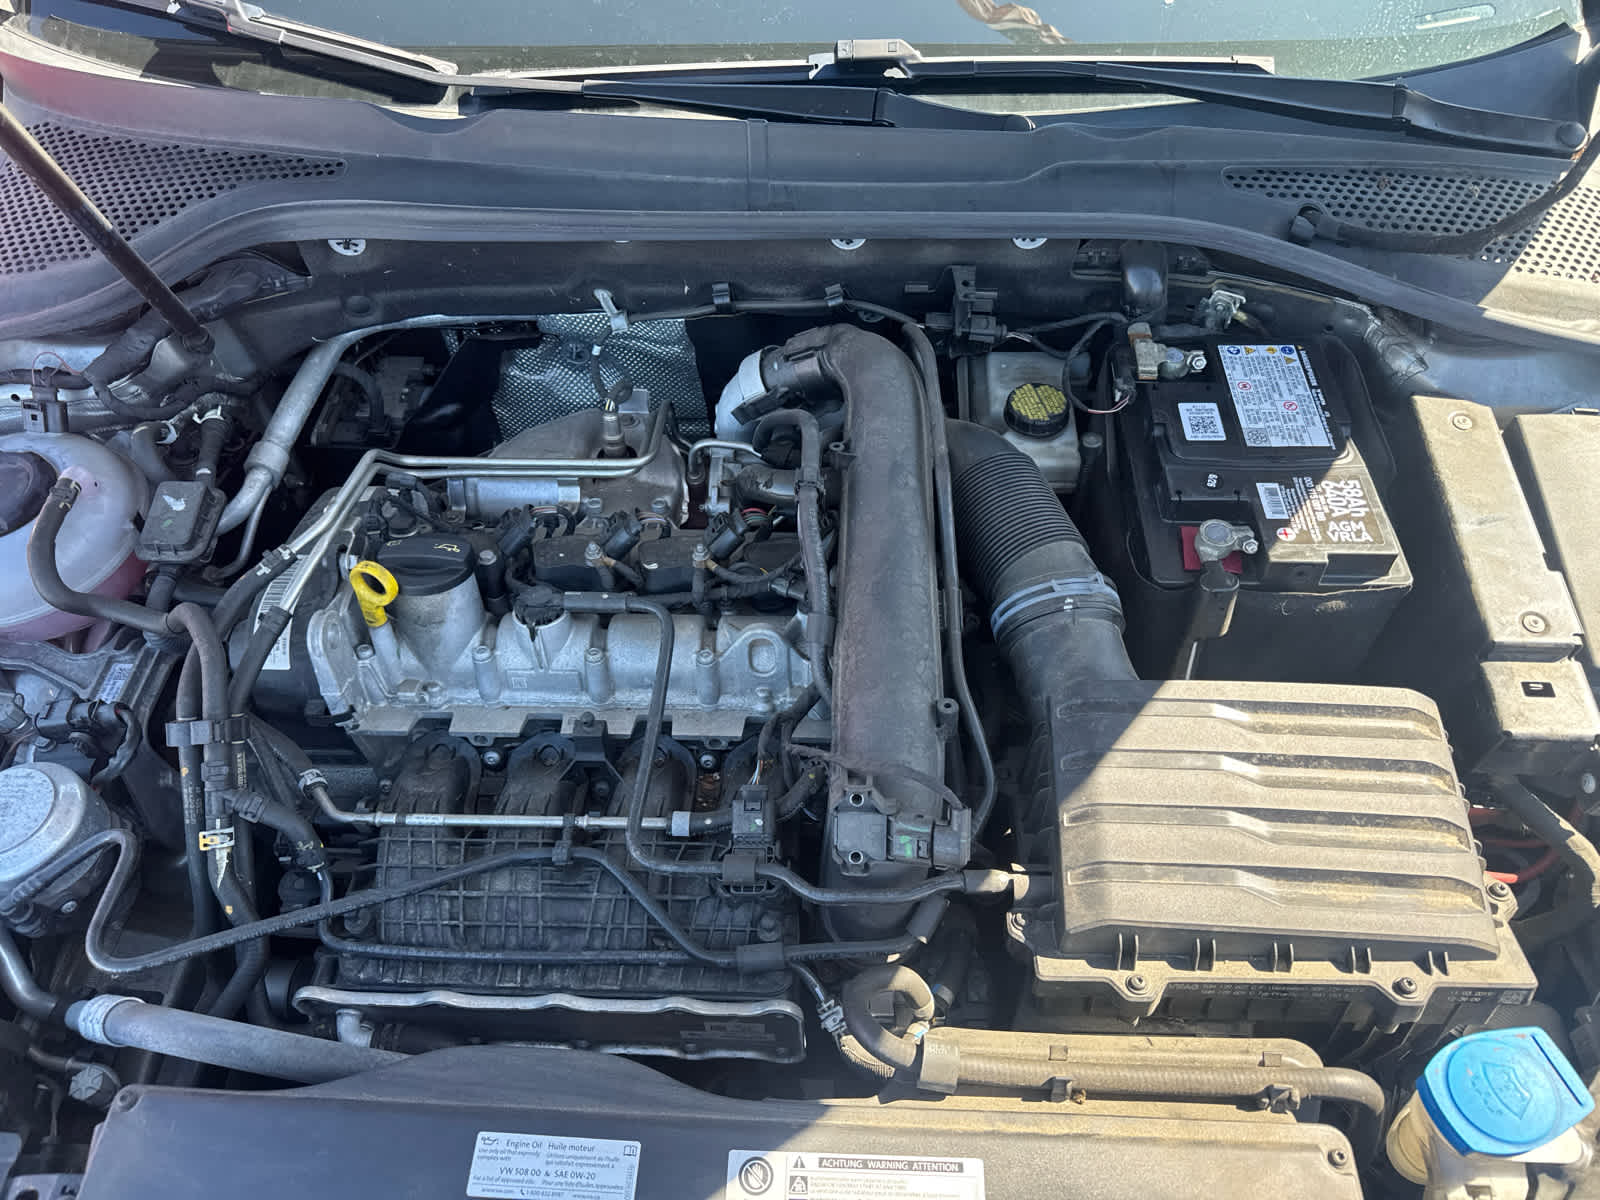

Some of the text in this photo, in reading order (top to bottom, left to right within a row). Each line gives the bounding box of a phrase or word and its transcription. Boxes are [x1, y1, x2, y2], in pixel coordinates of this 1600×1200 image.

[1321, 480, 1351, 517] 640A
[1340, 480, 1370, 517] 58Ah
[1328, 521, 1367, 532] AGM
[1326, 531, 1374, 542] VRLA
[506, 1139, 543, 1150] Engine Oil
[548, 1142, 594, 1152] Huile moteur
[821, 1158, 959, 1172] ACHTUNG WARNING ATTENTION
[499, 1168, 514, 1176] VW
[515, 1168, 529, 1176] 508
[530, 1169, 542, 1177] 00
[554, 1170, 568, 1178] SAE
[570, 1171, 596, 1180] 0W-20
